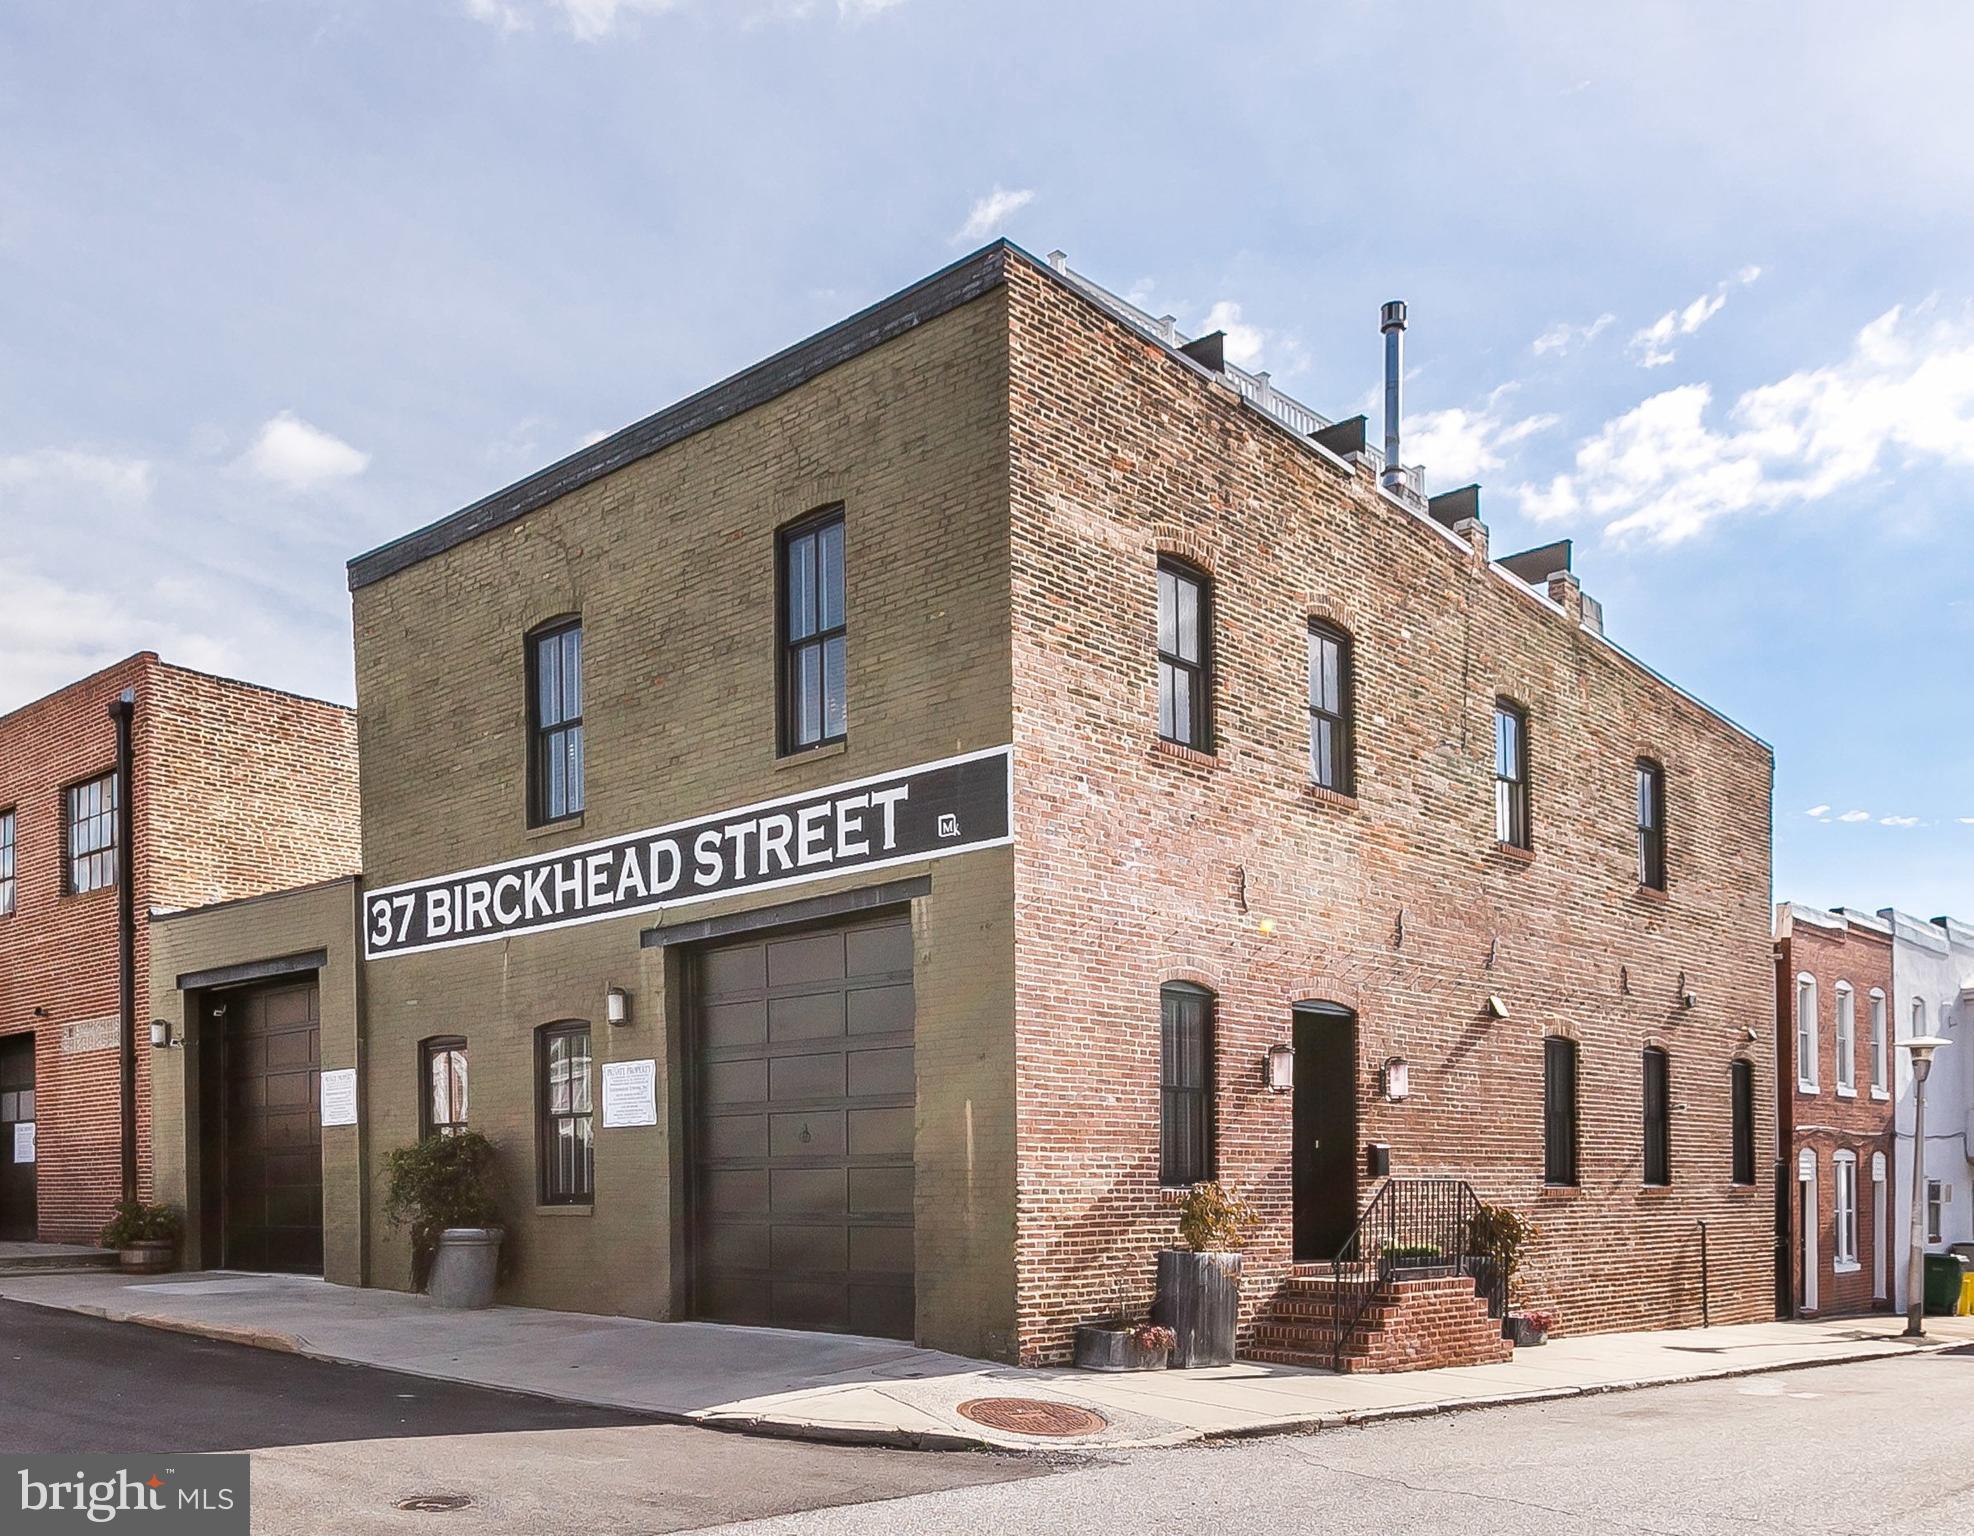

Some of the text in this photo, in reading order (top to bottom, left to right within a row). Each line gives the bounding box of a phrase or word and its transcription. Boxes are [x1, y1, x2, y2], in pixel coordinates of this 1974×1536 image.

[371, 784, 909, 947] 37 BIRCKHEAD STREET
